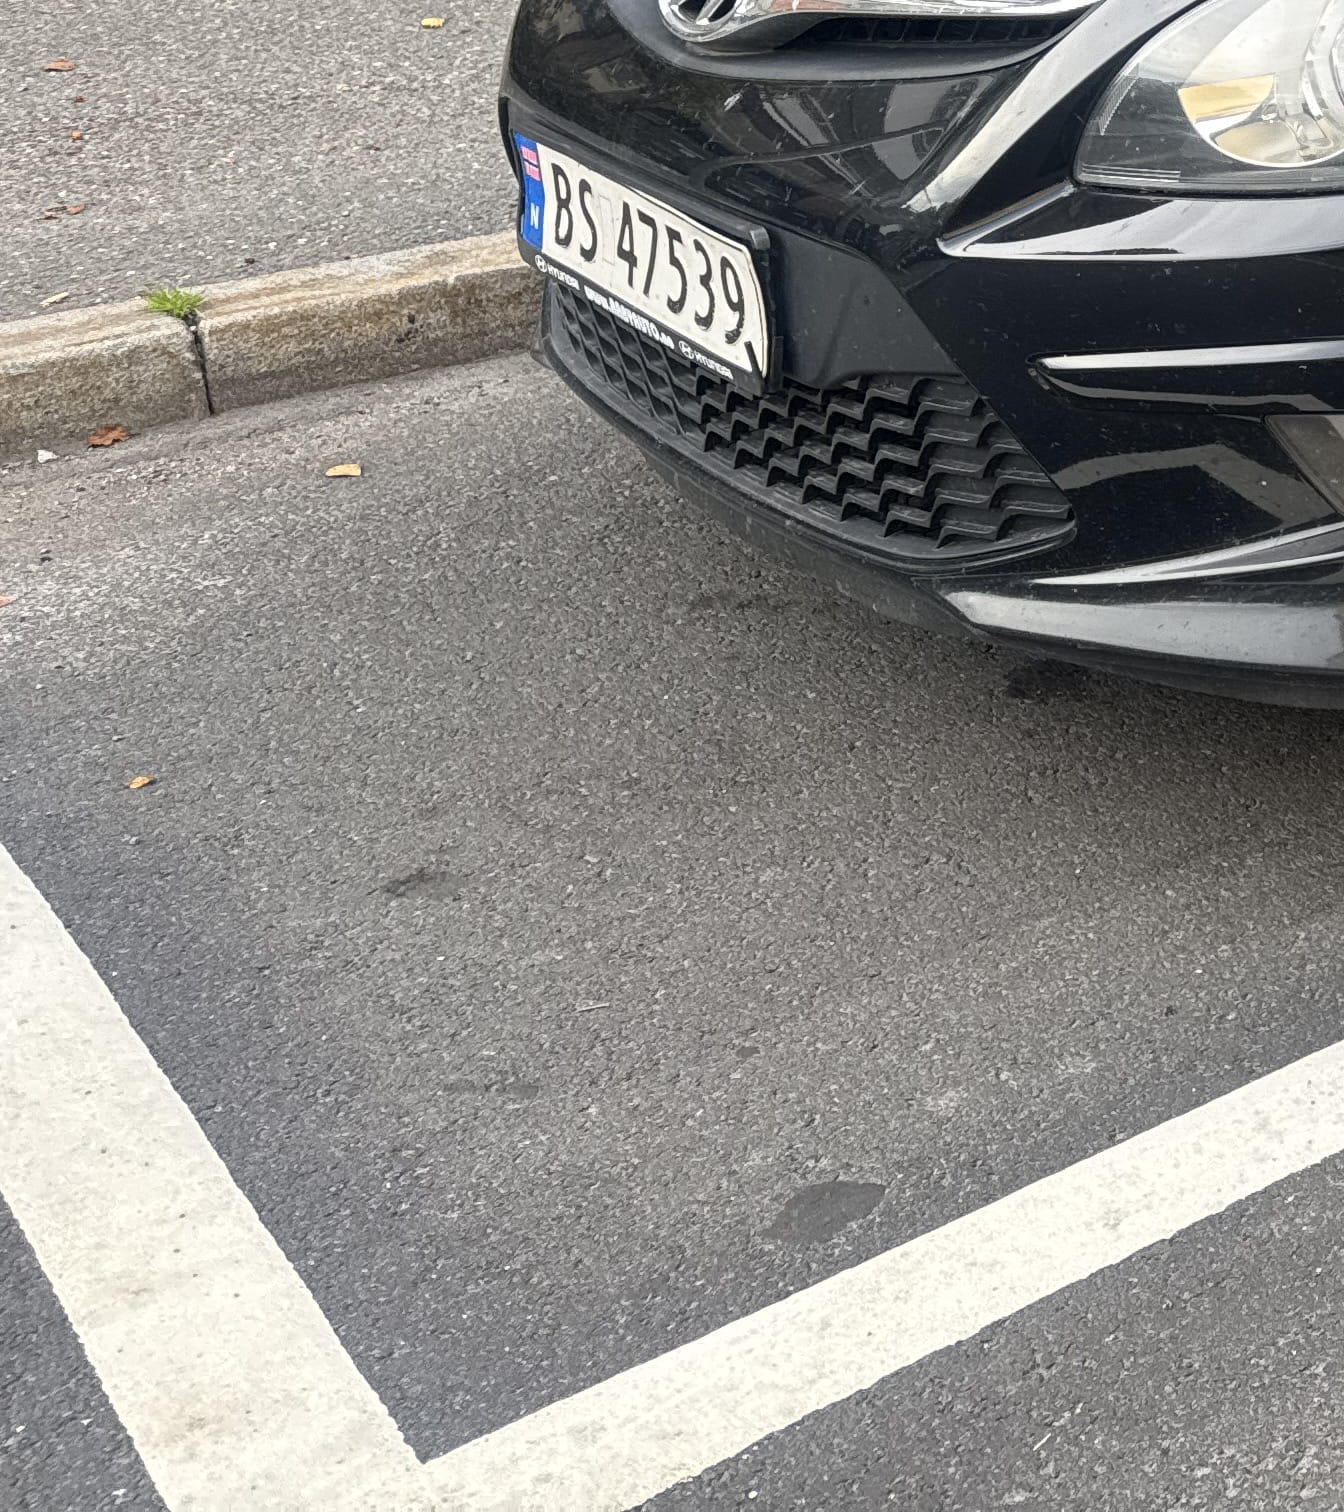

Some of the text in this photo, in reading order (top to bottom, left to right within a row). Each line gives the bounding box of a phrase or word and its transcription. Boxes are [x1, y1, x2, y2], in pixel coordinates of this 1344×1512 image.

[530, 205, 540, 229] N
[551, 162, 746, 345] BS 47539
